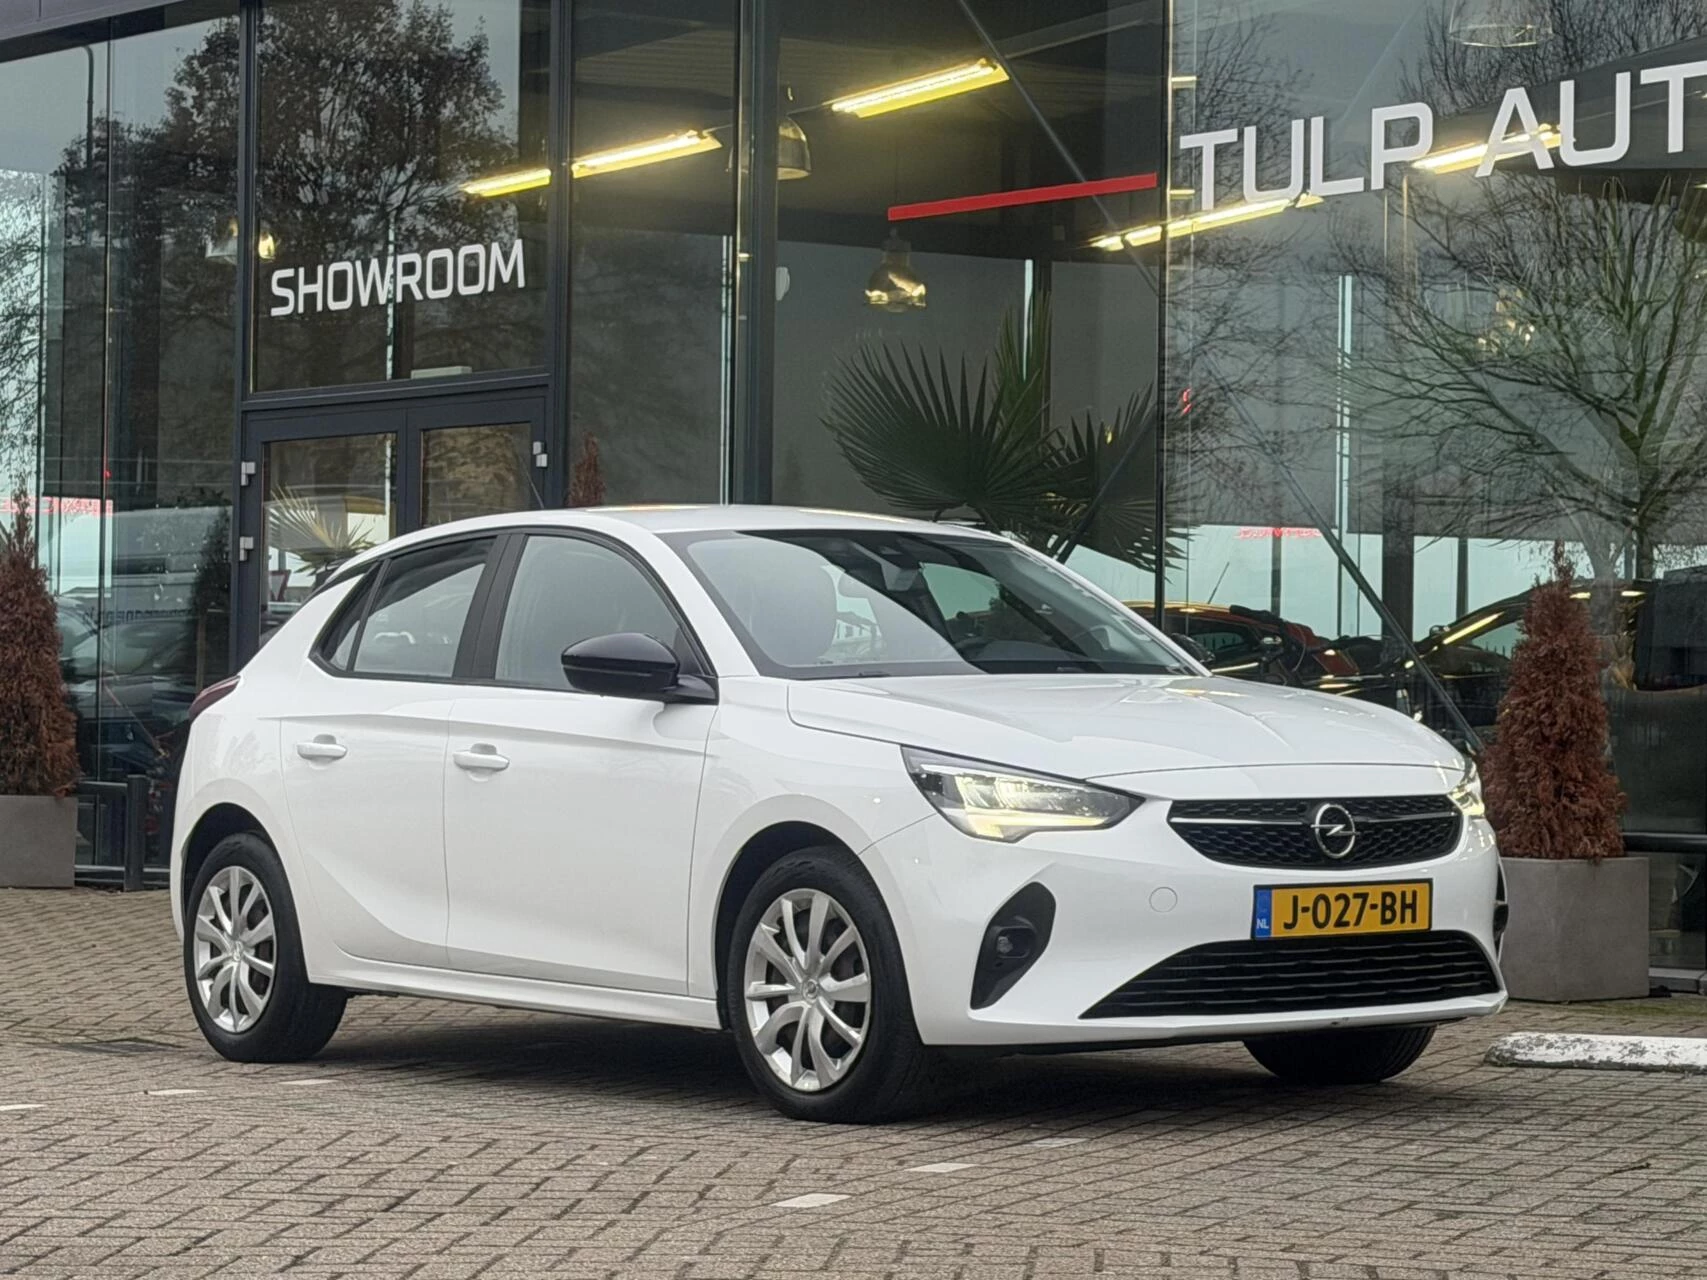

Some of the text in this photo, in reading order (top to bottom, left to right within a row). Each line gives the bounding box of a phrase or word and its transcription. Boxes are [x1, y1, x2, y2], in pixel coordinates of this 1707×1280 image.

[1179, 60, 1707, 211] TULP AUT
[270, 239, 525, 317] SHOWROOM
[1256, 918, 1270, 929] NL
[1283, 889, 1418, 930] J-027-BH
